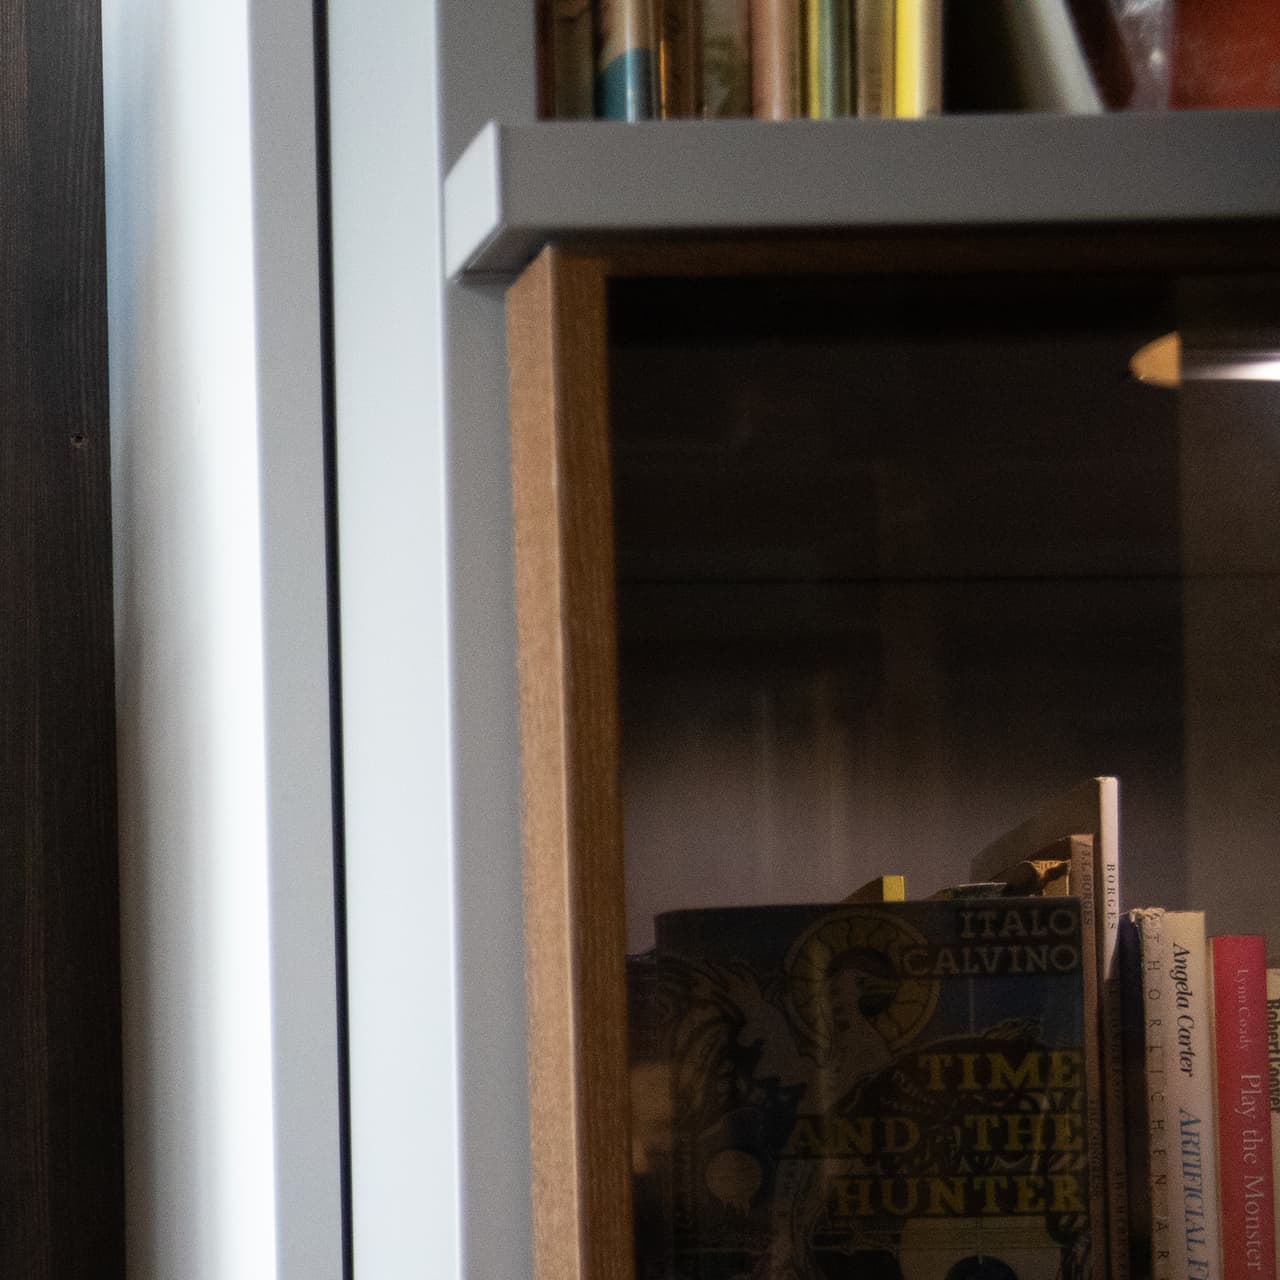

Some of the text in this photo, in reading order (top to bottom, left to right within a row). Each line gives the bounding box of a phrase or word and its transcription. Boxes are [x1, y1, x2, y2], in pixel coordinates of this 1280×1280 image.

[1106, 864, 1117, 929] BORGES
[959, 908, 1079, 940] ITALO
[903, 943, 1079, 976] CALVINO
[1170, 942, 1196, 1078] Angela Carter
[1231, 967, 1252, 1053] Lynn Coady
[918, 1050, 1083, 1092] TIME
[1234, 1073, 1263, 1119] Play
[783, 1112, 1084, 1156] AND THE
[1242, 1129, 1264, 1165] the
[832, 1175, 1084, 1217] HUNTER
[1178, 1107, 1206, 1251] ARTIFICIAL
[1241, 1174, 1265, 1272] Monster
